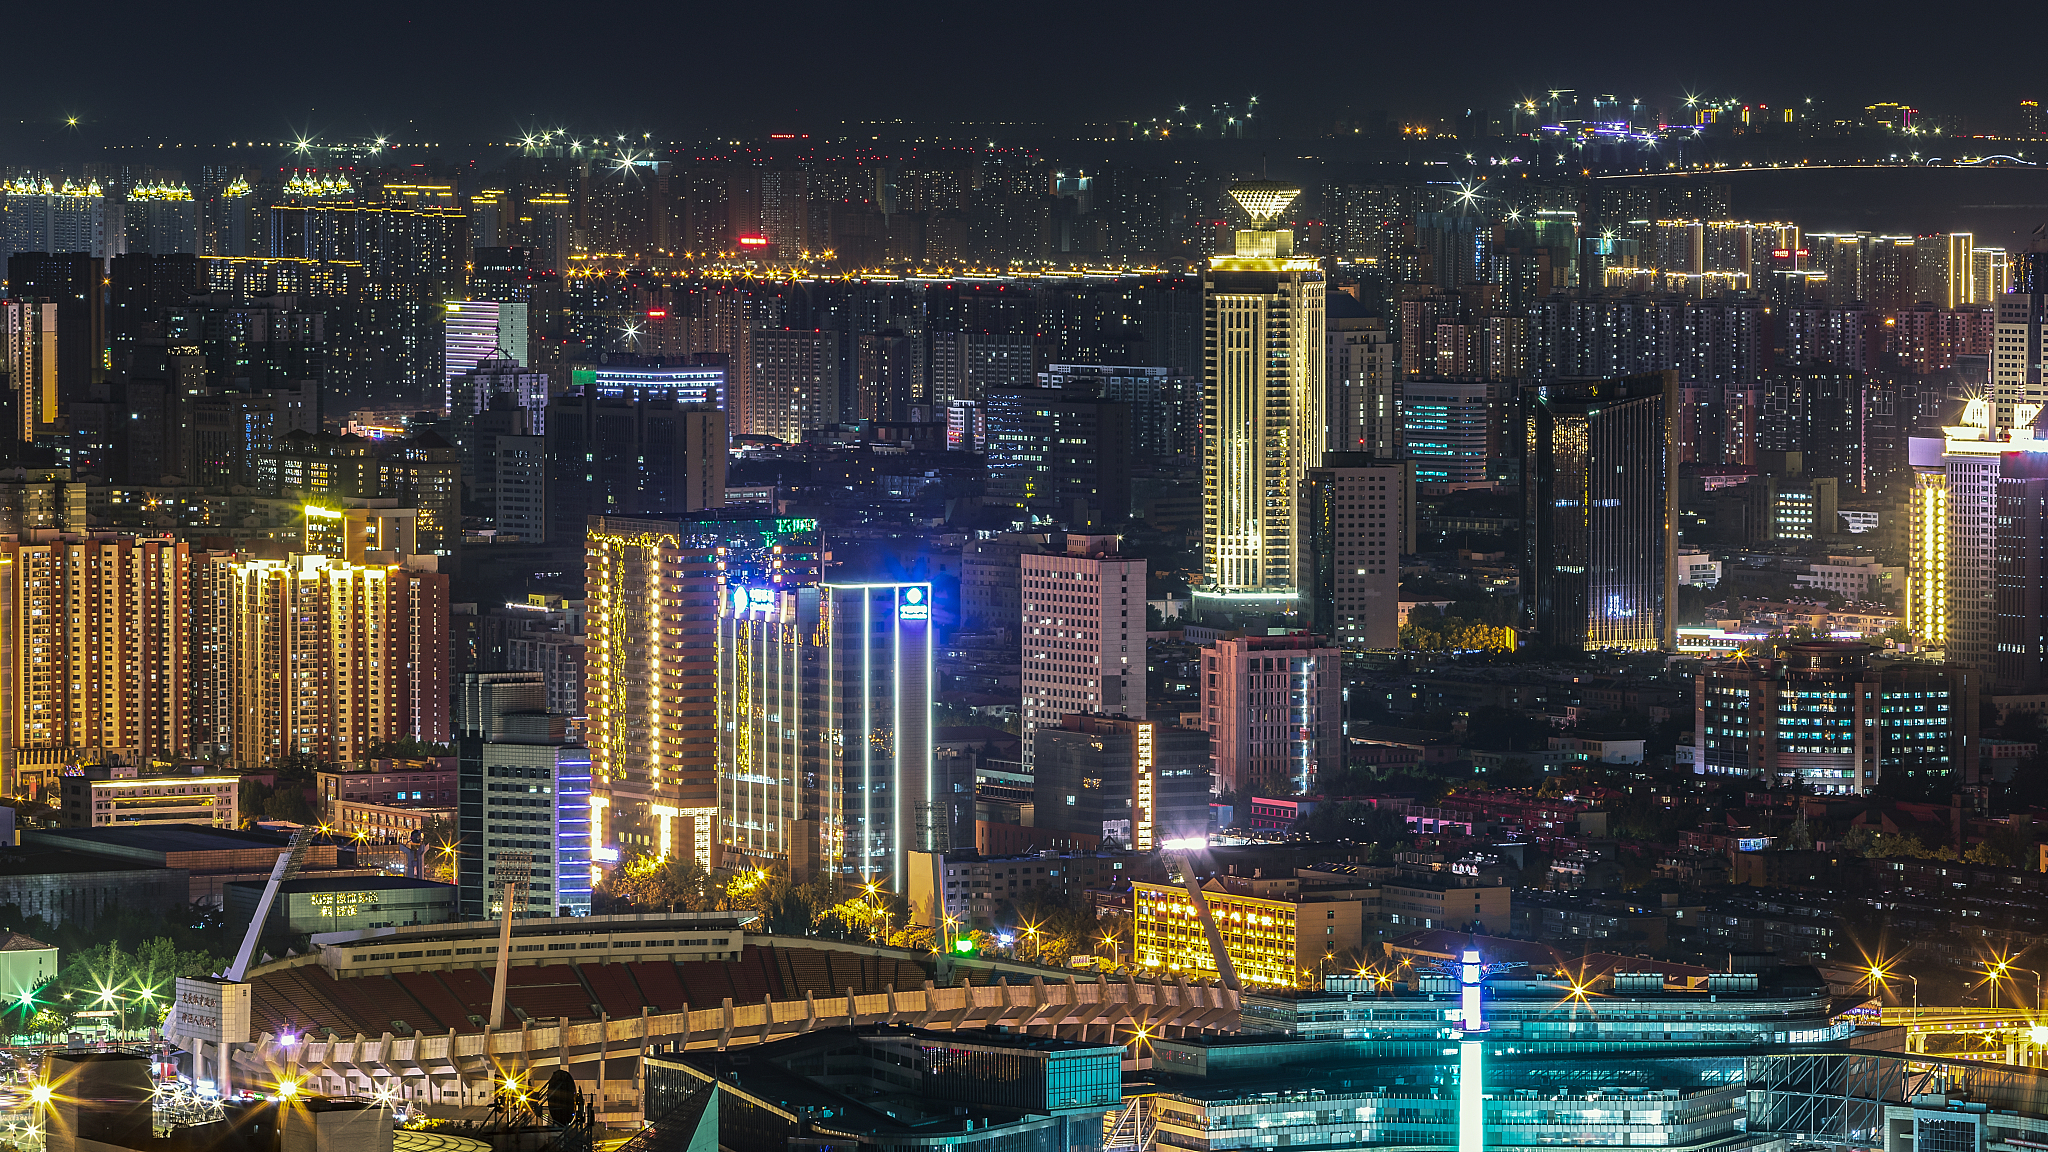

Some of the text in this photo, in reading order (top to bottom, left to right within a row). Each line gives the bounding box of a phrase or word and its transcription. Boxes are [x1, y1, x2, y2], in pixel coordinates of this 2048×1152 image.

[1156, 900, 1274, 927] 山东电中心医院
